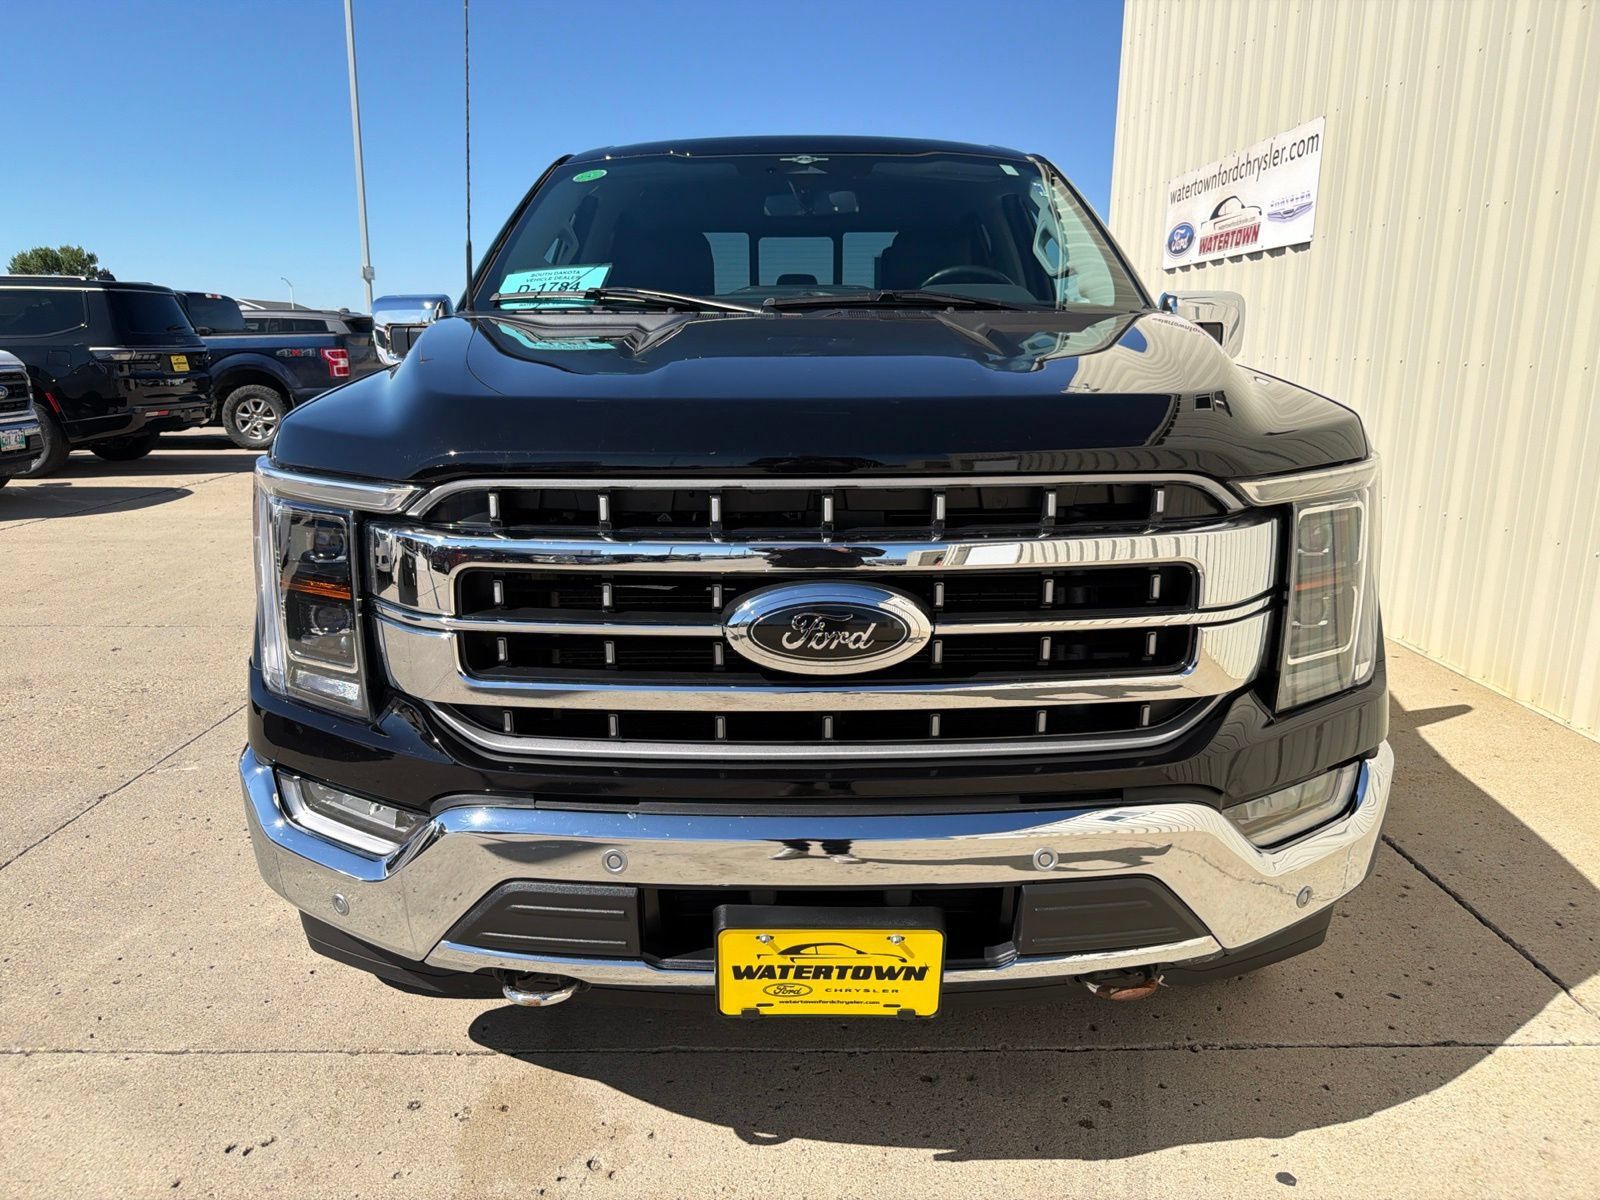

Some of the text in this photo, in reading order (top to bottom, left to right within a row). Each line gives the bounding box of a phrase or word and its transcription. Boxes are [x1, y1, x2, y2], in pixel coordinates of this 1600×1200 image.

[1170, 133, 1320, 205] watertownfordchrysler.com
[1199, 223, 1261, 256] WATERTOWN
[782, 613, 876, 649] Ford
[732, 964, 929, 981] WATERTOWN
[773, 984, 801, 995] Ford
